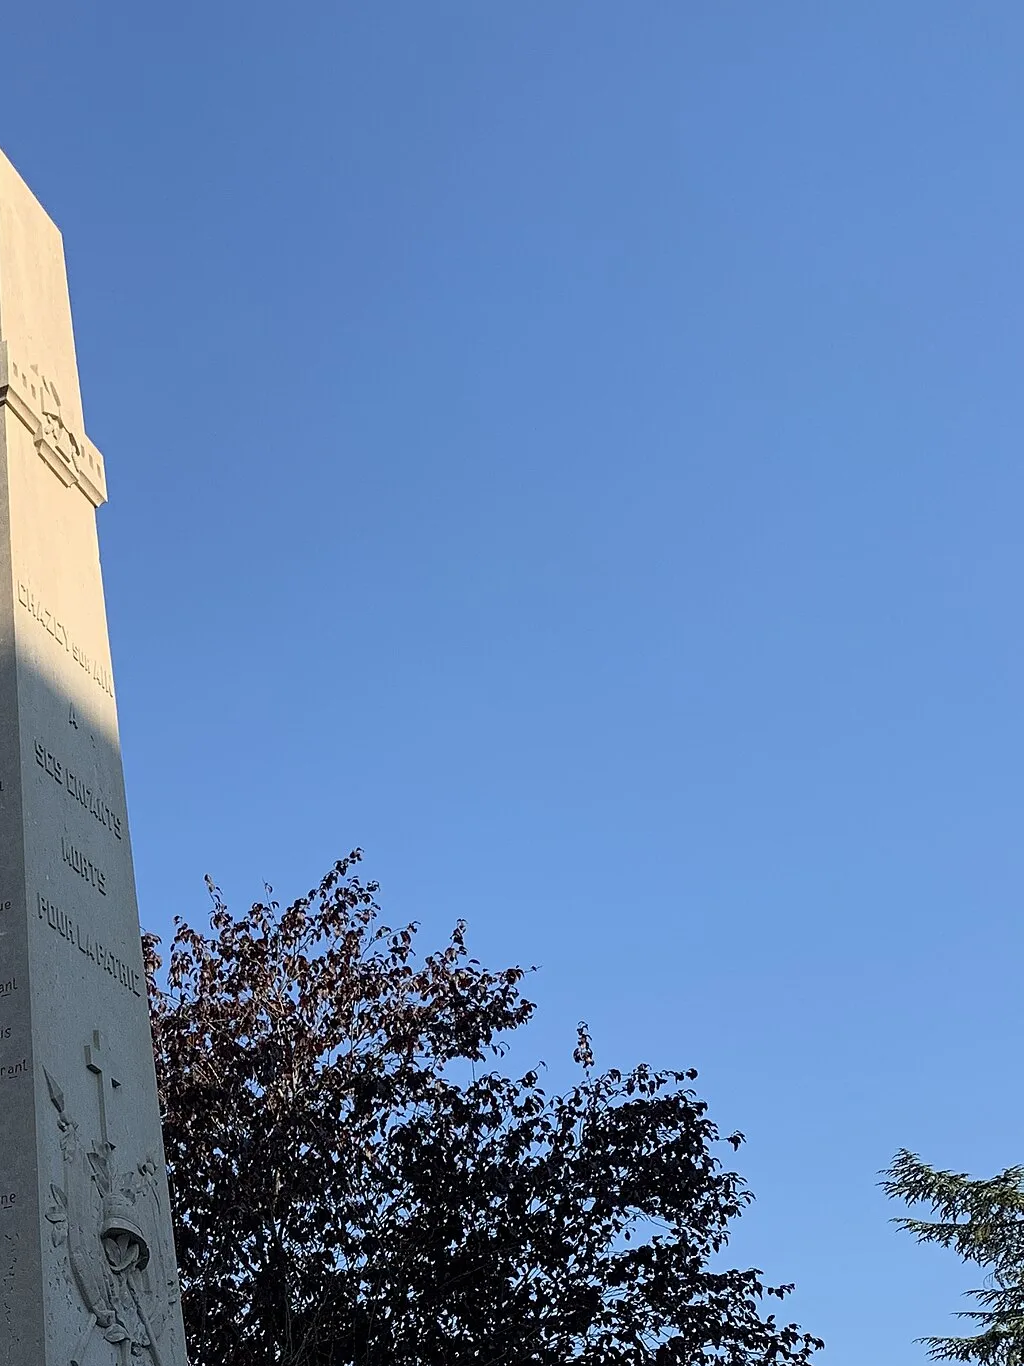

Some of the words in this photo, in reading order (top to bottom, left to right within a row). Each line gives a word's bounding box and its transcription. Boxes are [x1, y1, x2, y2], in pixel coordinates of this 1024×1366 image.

[17, 579, 69, 653] CHAZEY
[34, 739, 63, 785] SES
[66, 768, 122, 840] ENFANTS
[61, 837, 107, 896] MORTS
[37, 892, 75, 945] POUR
[77, 924, 95, 960] LA
[95, 942, 141, 998] PATRIE
